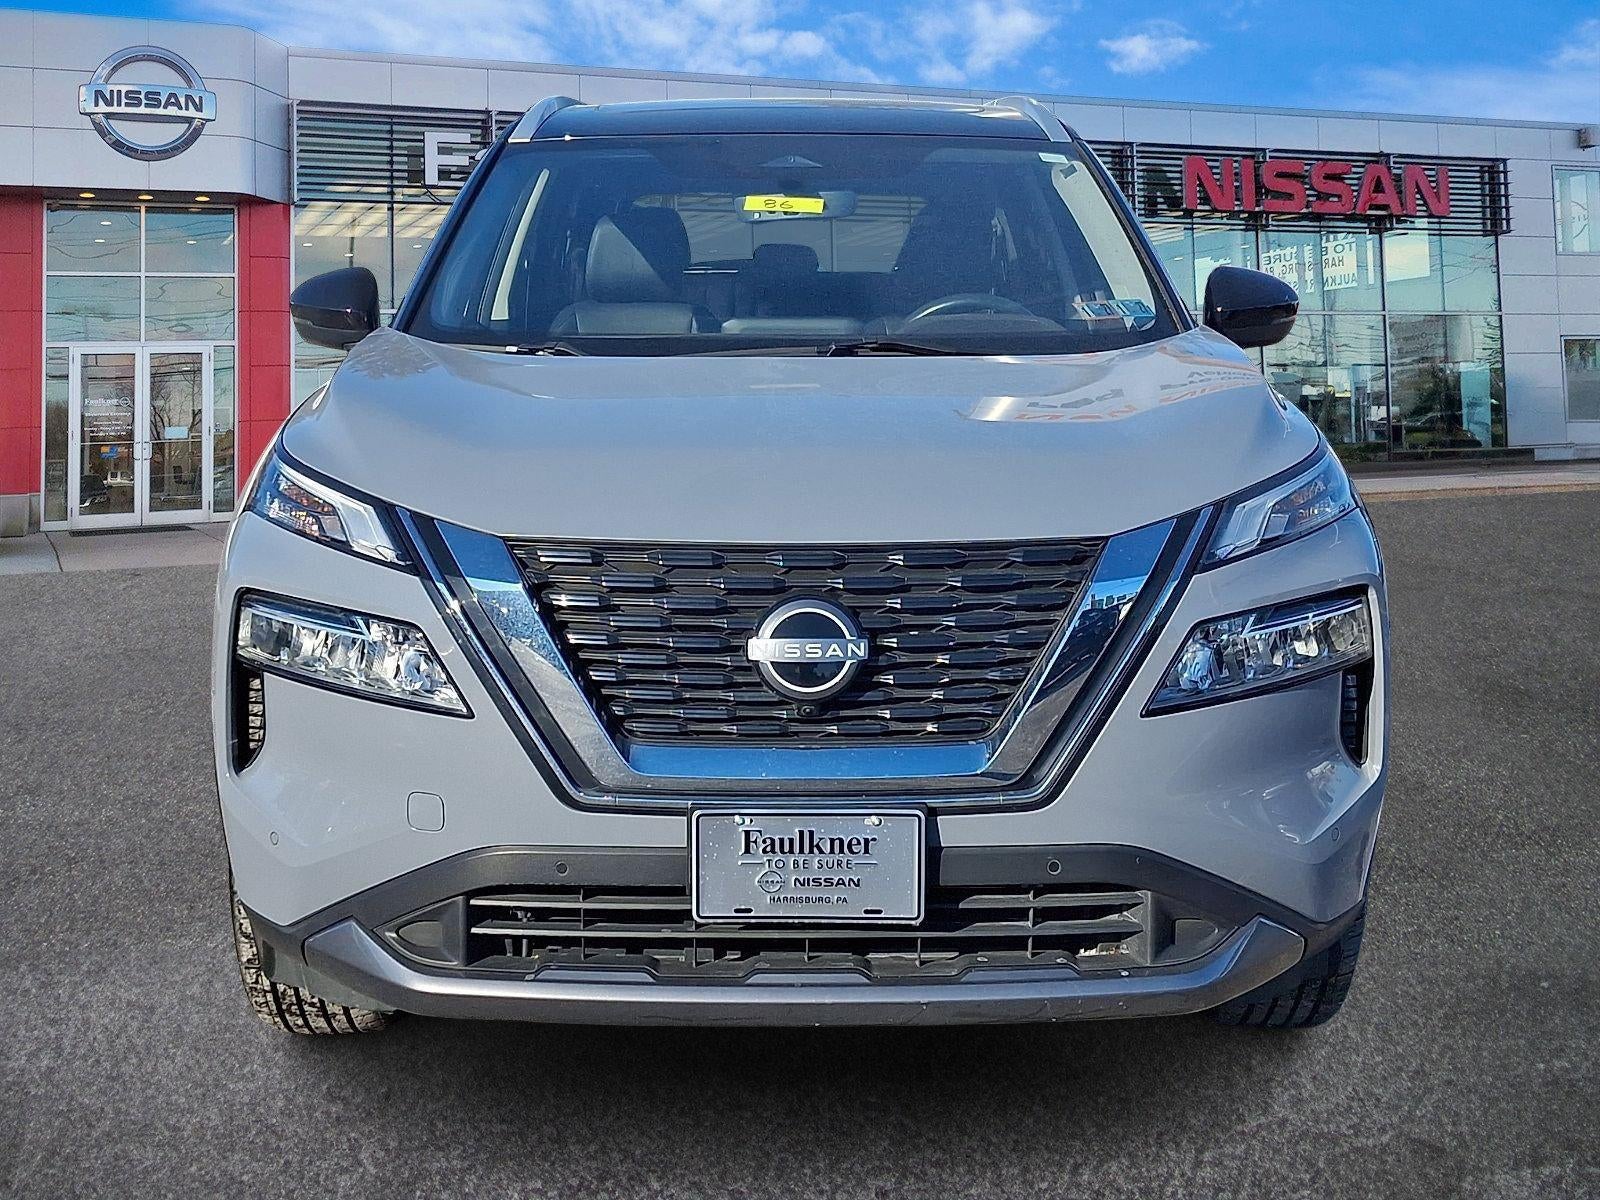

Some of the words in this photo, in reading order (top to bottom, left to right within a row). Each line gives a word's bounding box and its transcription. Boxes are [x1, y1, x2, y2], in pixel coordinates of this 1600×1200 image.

[93, 88, 204, 115] NISSAN
[1182, 155, 1451, 217] NISSAN
[763, 198, 794, 210] 86
[750, 641, 866, 659] NISSAN
[739, 828, 878, 856] Faulkner
[766, 858, 785, 870] TO
[792, 858, 809, 870] BE
[817, 858, 854, 870] SURE
[793, 877, 861, 888] NISSAN
[769, 895, 834, 906] HARRISBURG,
[836, 895, 848, 905] PA
